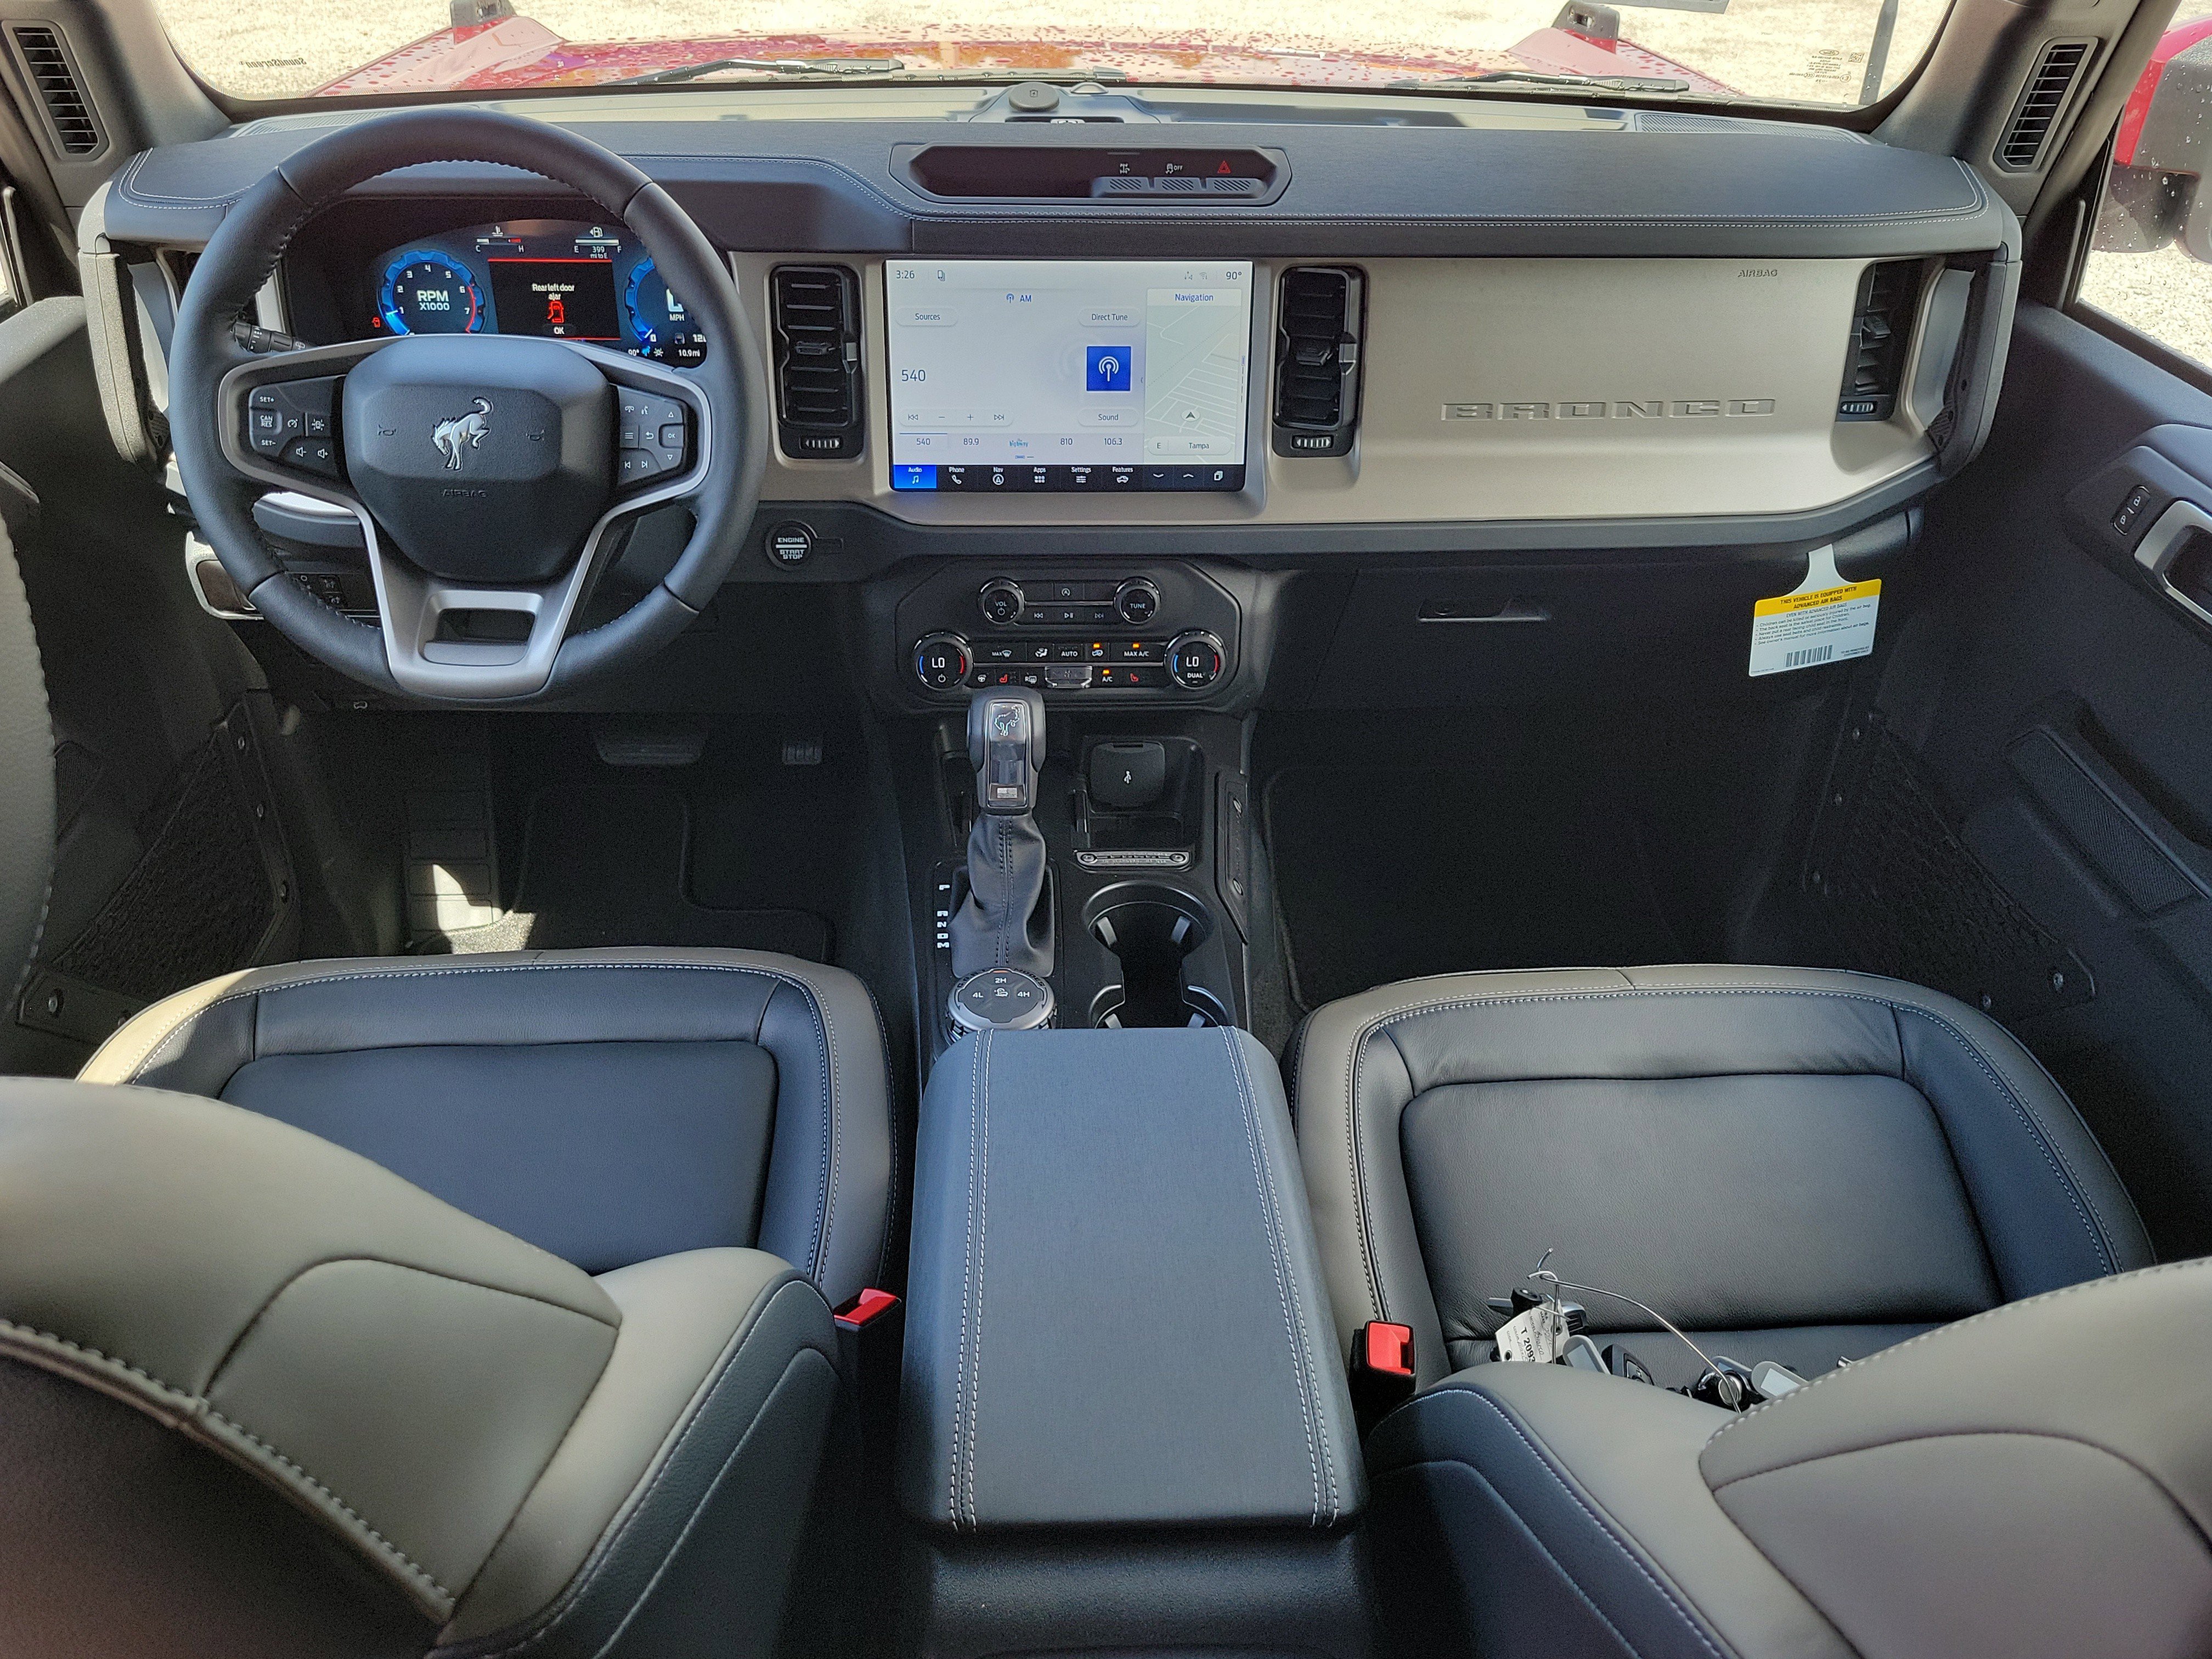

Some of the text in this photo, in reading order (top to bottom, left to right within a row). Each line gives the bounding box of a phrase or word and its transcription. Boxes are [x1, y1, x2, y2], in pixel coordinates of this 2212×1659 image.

[518, 245, 524, 253] H
[406, 270, 413, 279] 3
[445, 270, 452, 279] 5
[896, 270, 915, 280] 3:26
[1226, 271, 1243, 280] 90°
[1737, 269, 1778, 278] AIRBAG
[532, 283, 575, 292] Rear left door
[416, 290, 449, 302] RPM
[549, 292, 561, 301] ajar
[1019, 294, 1032, 303] AM
[1175, 293, 1214, 303] Navigation
[399, 306, 404, 314] 1
[419, 302, 450, 311] X1000
[464, 307, 471, 315] 7
[915, 312, 941, 321] Sources
[1091, 312, 1128, 321] Direct Tune
[553, 326, 565, 335] OK
[650, 334, 657, 342] 0
[901, 369, 927, 383] 540
[1441, 398, 1776, 421] BRONCO
[1098, 413, 1119, 422] Sound
[1820, 589, 1843, 597] EQUIPPED
[1793, 601, 1819, 609] ADVANCED
[932, 657, 945, 669] LO
[1186, 656, 1199, 668] LO
[1521, 1327, 1528, 1335] T
